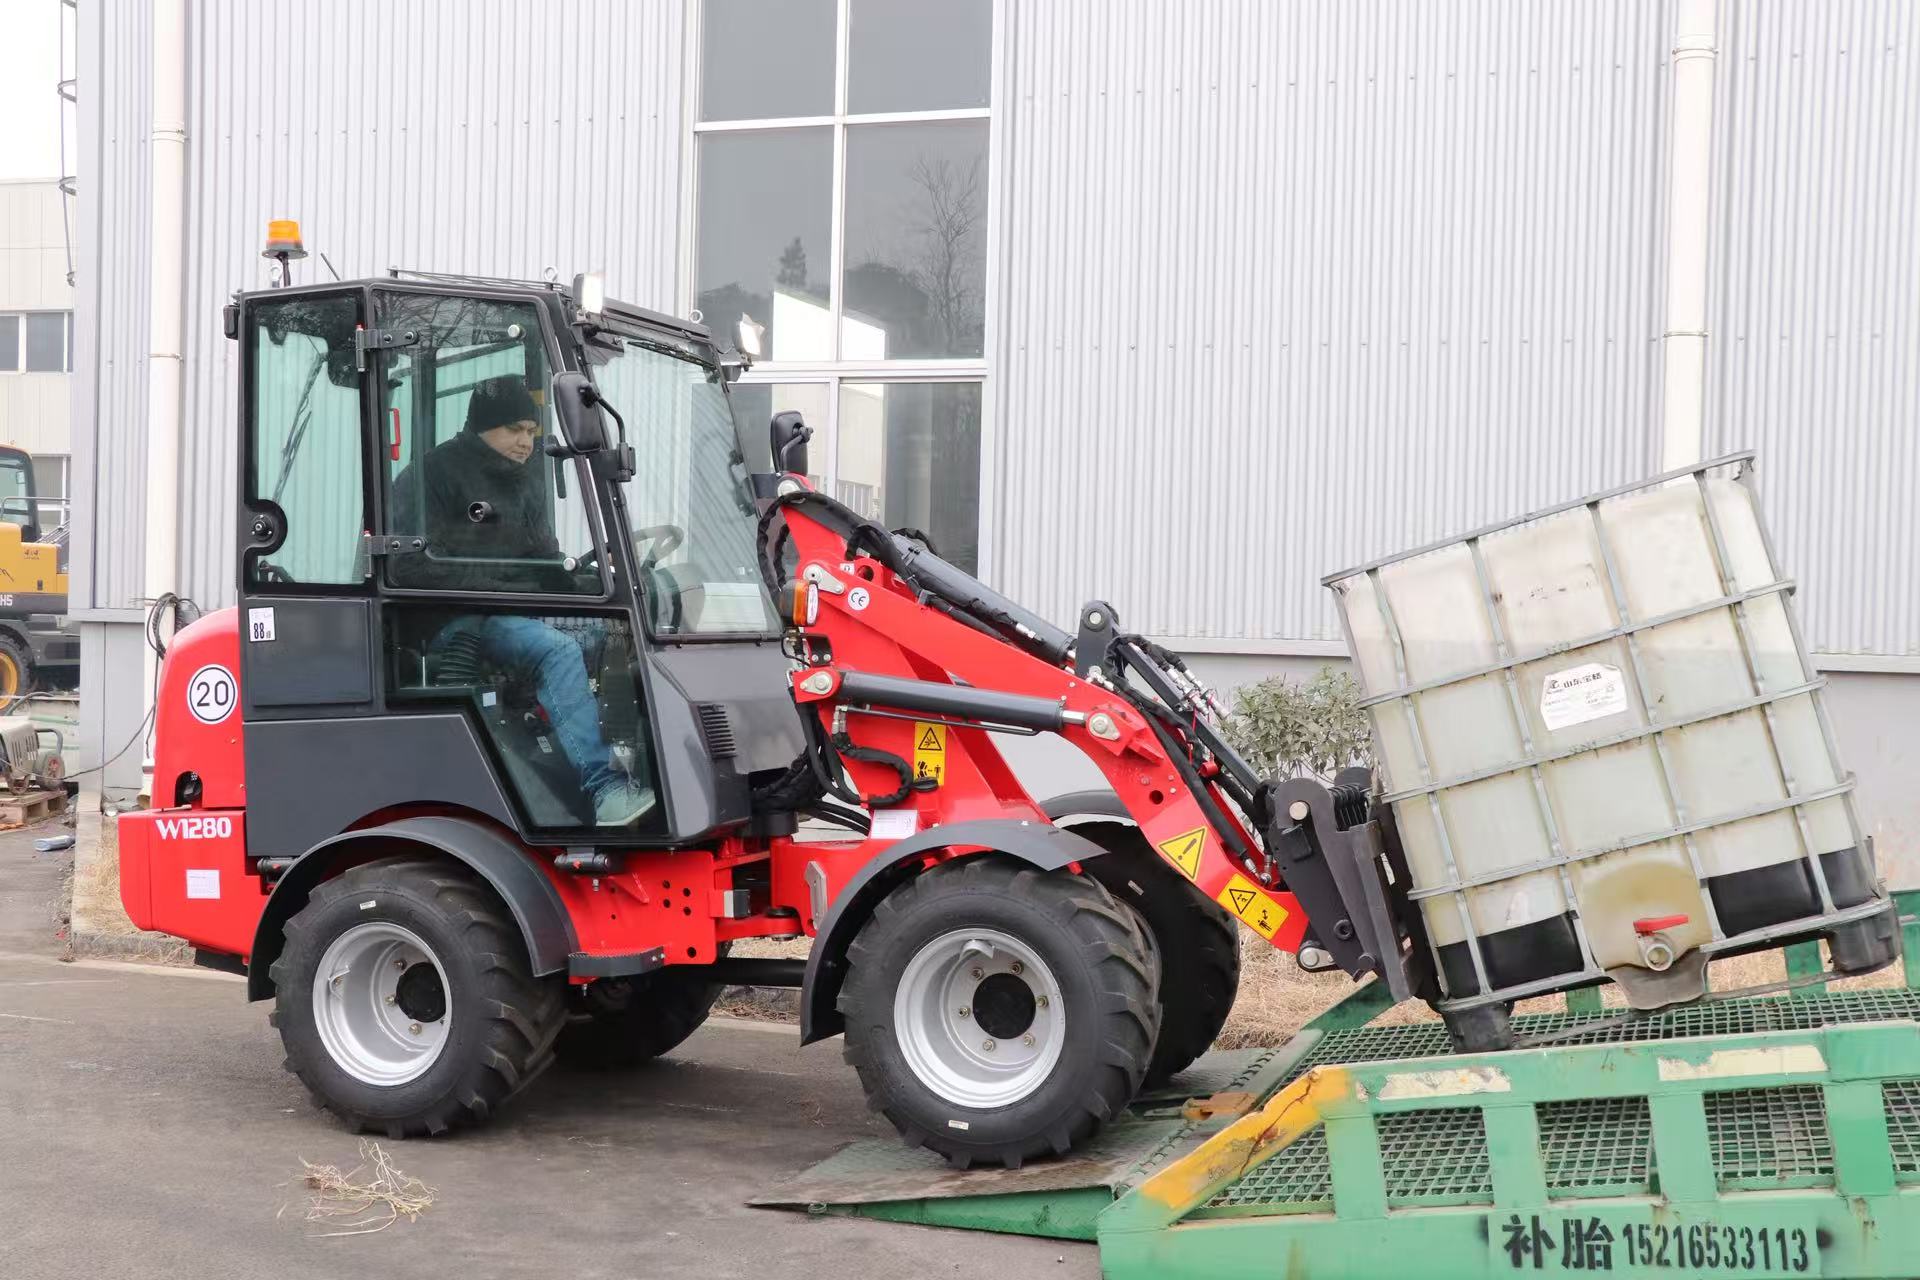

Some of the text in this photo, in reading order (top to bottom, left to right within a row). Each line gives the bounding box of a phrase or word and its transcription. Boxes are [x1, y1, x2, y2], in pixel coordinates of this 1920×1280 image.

[850, 592, 867, 607] CE
[253, 622, 265, 639] 88
[196, 680, 230, 707] 20
[155, 817, 232, 840] W1280
[1501, 1214, 1809, 1273] 补胎 15216533113
